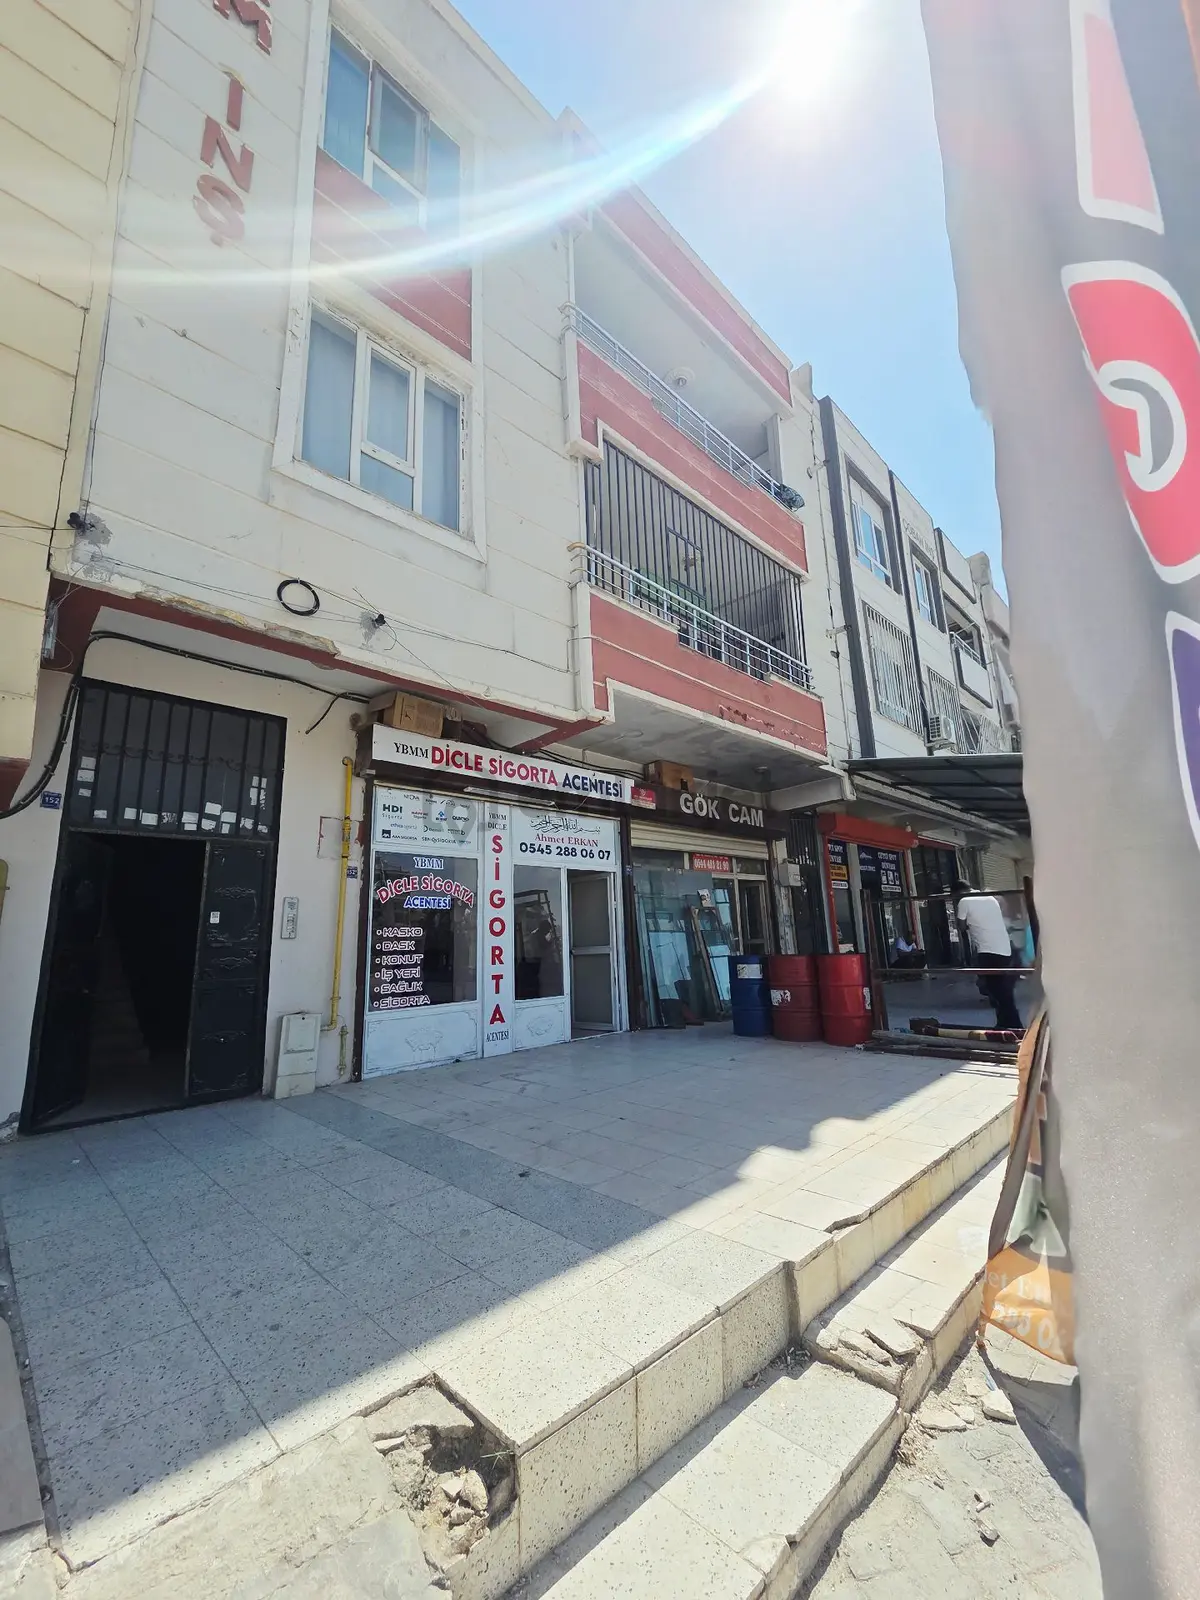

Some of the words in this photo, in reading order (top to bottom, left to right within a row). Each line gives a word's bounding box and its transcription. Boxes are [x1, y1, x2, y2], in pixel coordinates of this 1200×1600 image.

[393, 742, 429, 759] YBMM
[431, 743, 483, 773] DİCLE
[488, 755, 558, 786] SİGORTA
[382, 803, 403, 813] HDI
[680, 792, 720, 820] GÖK
[728, 803, 764, 828] CAM
[535, 833, 565, 844] Ahmet
[567, 836, 599, 848] ERKAN
[519, 842, 552, 855] 0545
[555, 846, 578, 858] 288
[580, 848, 595, 859] 06
[597, 850, 611, 861] 07
[413, 856, 444, 870] YBMM
[377, 876, 420, 904] DİCLE
[421, 872, 475, 908] SİGORTA
[403, 895, 453, 910] ACENTESİ
[382, 927, 424, 937] KASKO
[488, 835, 506, 1025] SİGORTA
[382, 940, 416, 951] DASK
[381, 954, 424, 966] KONUT
[381, 967, 394, 982] İŞ
[394, 966, 421, 979] YERİ
[380, 980, 424, 995] SAĞLIK
[379, 994, 431, 1009] SİGORTA
